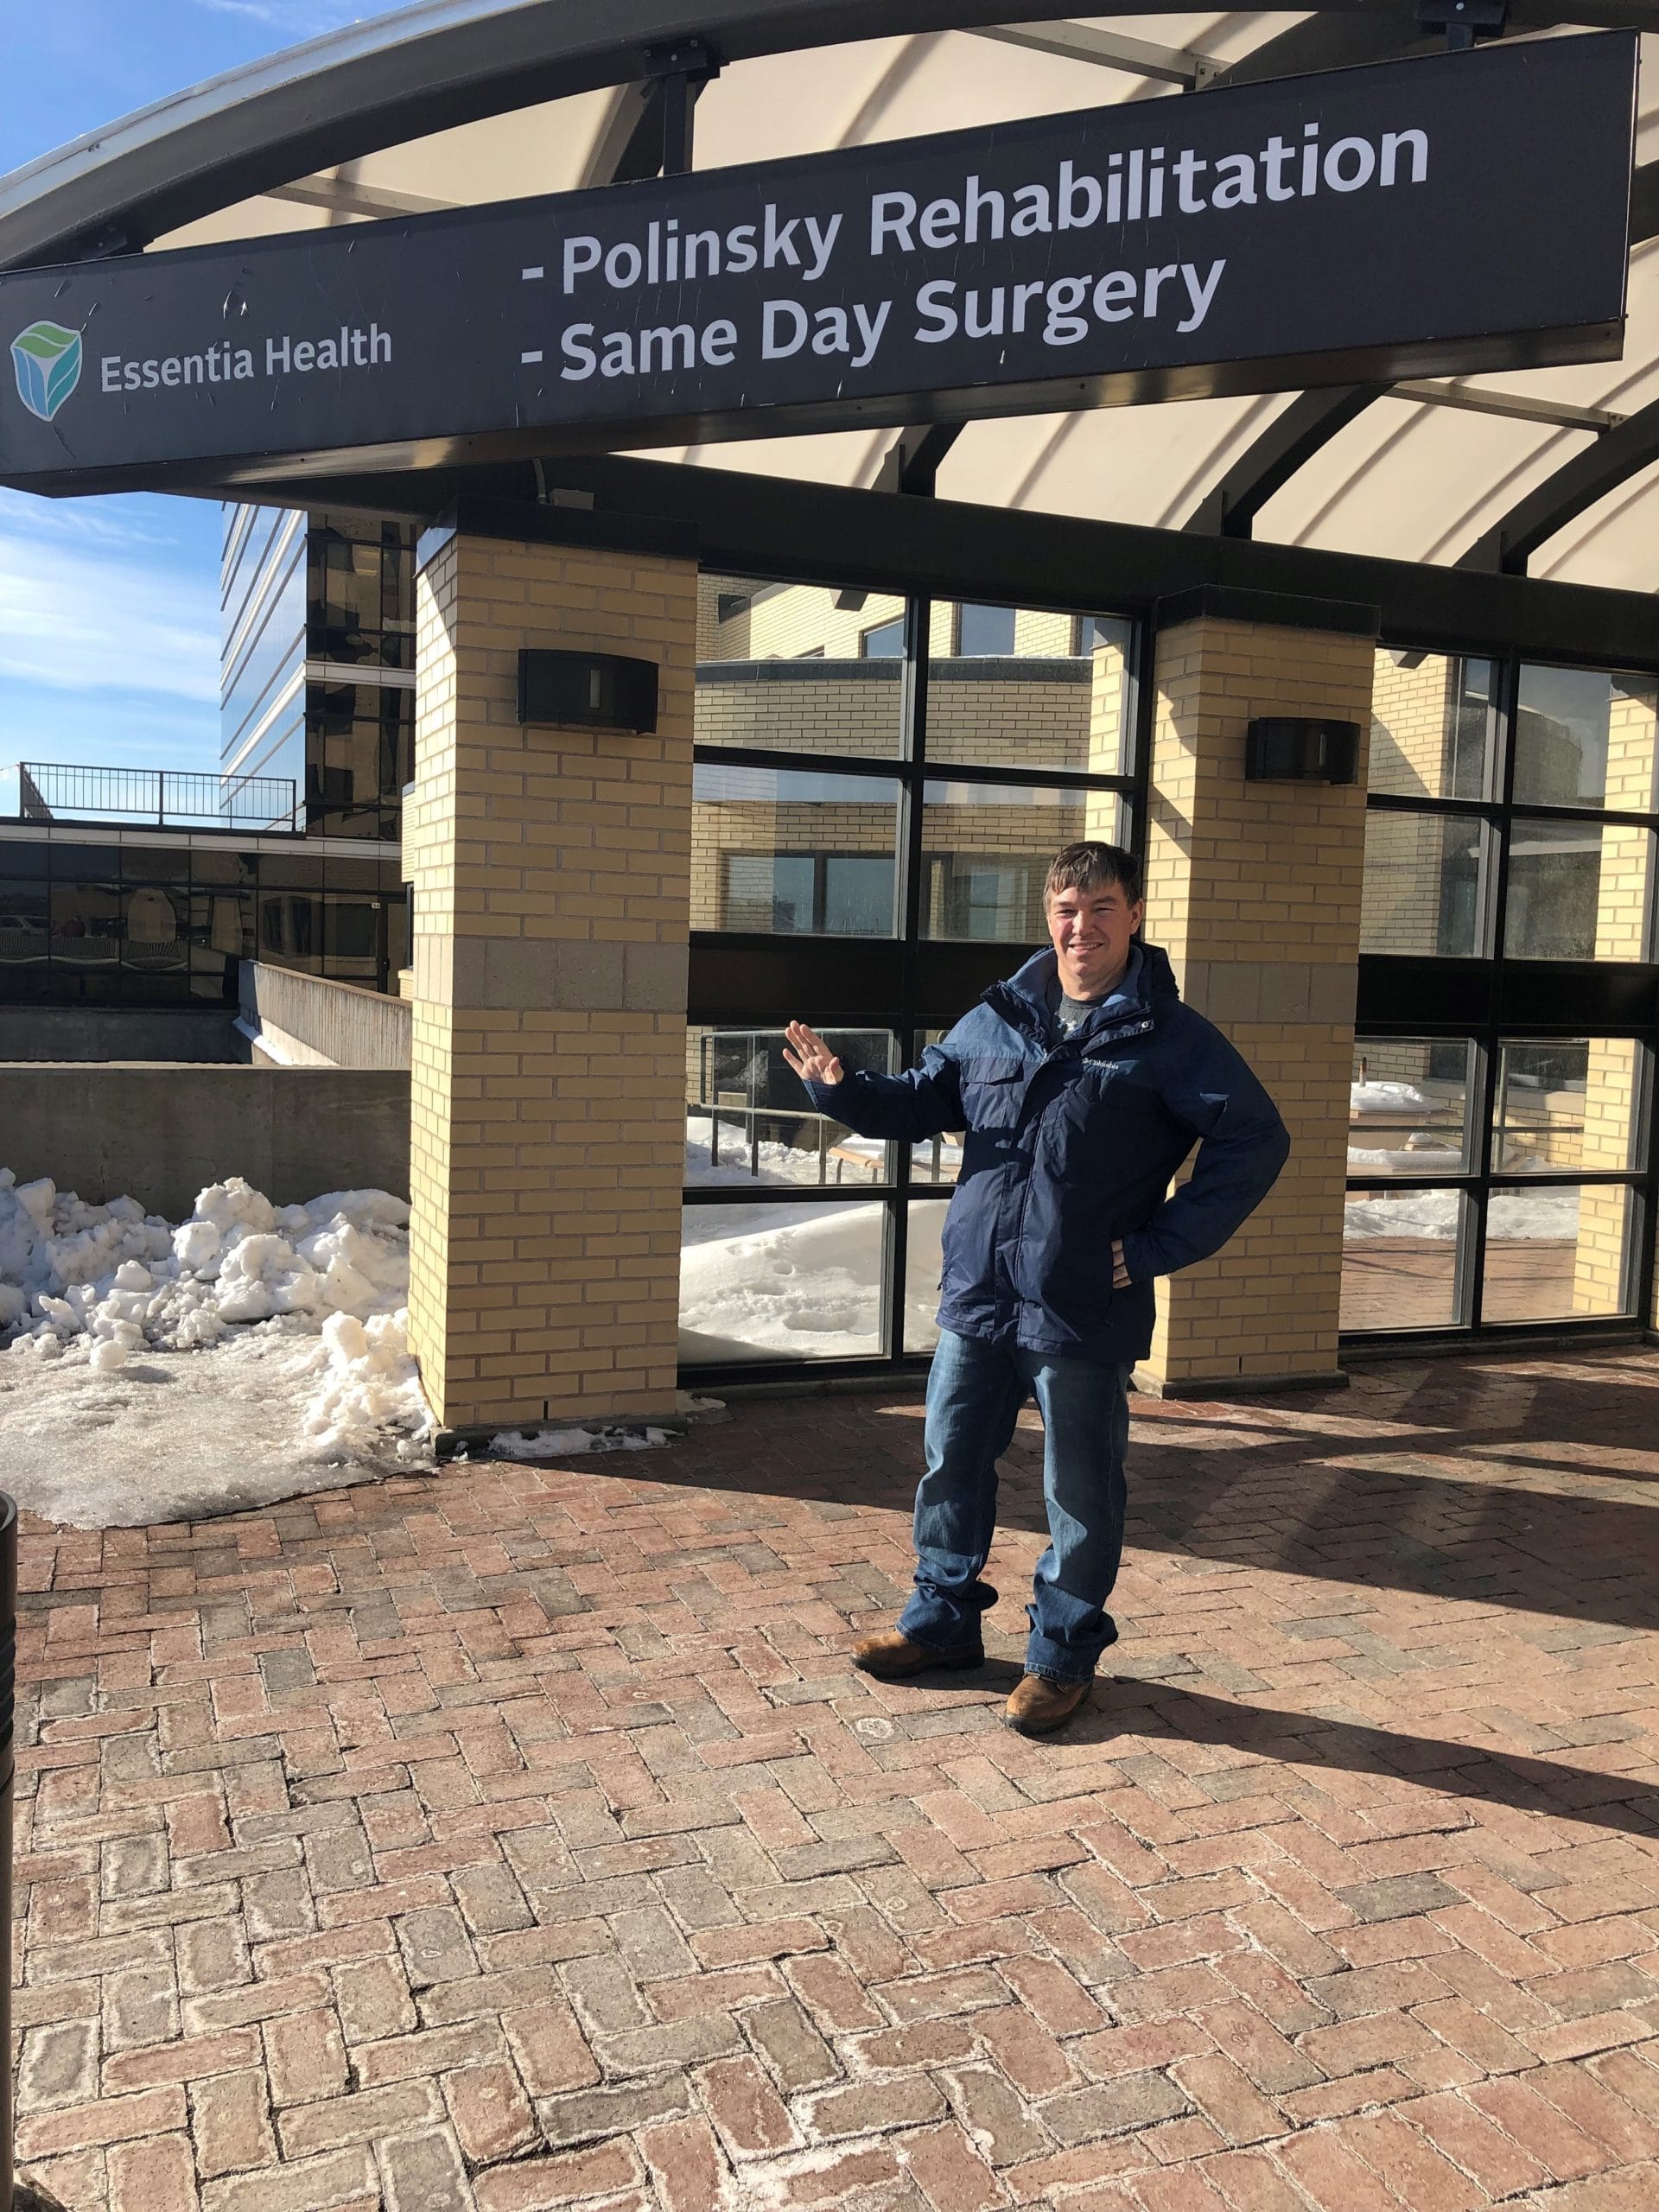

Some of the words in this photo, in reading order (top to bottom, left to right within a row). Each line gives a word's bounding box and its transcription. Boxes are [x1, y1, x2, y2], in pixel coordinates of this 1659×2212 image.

[563, 204, 843, 295] Polinsky
[870, 122, 1428, 256] Rehabilitation
[101, 342, 254, 392] Essentia
[266, 323, 391, 375] Health
[561, 319, 737, 381] Same
[761, 299, 892, 367] Day
[914, 259, 1227, 346] Surgery
